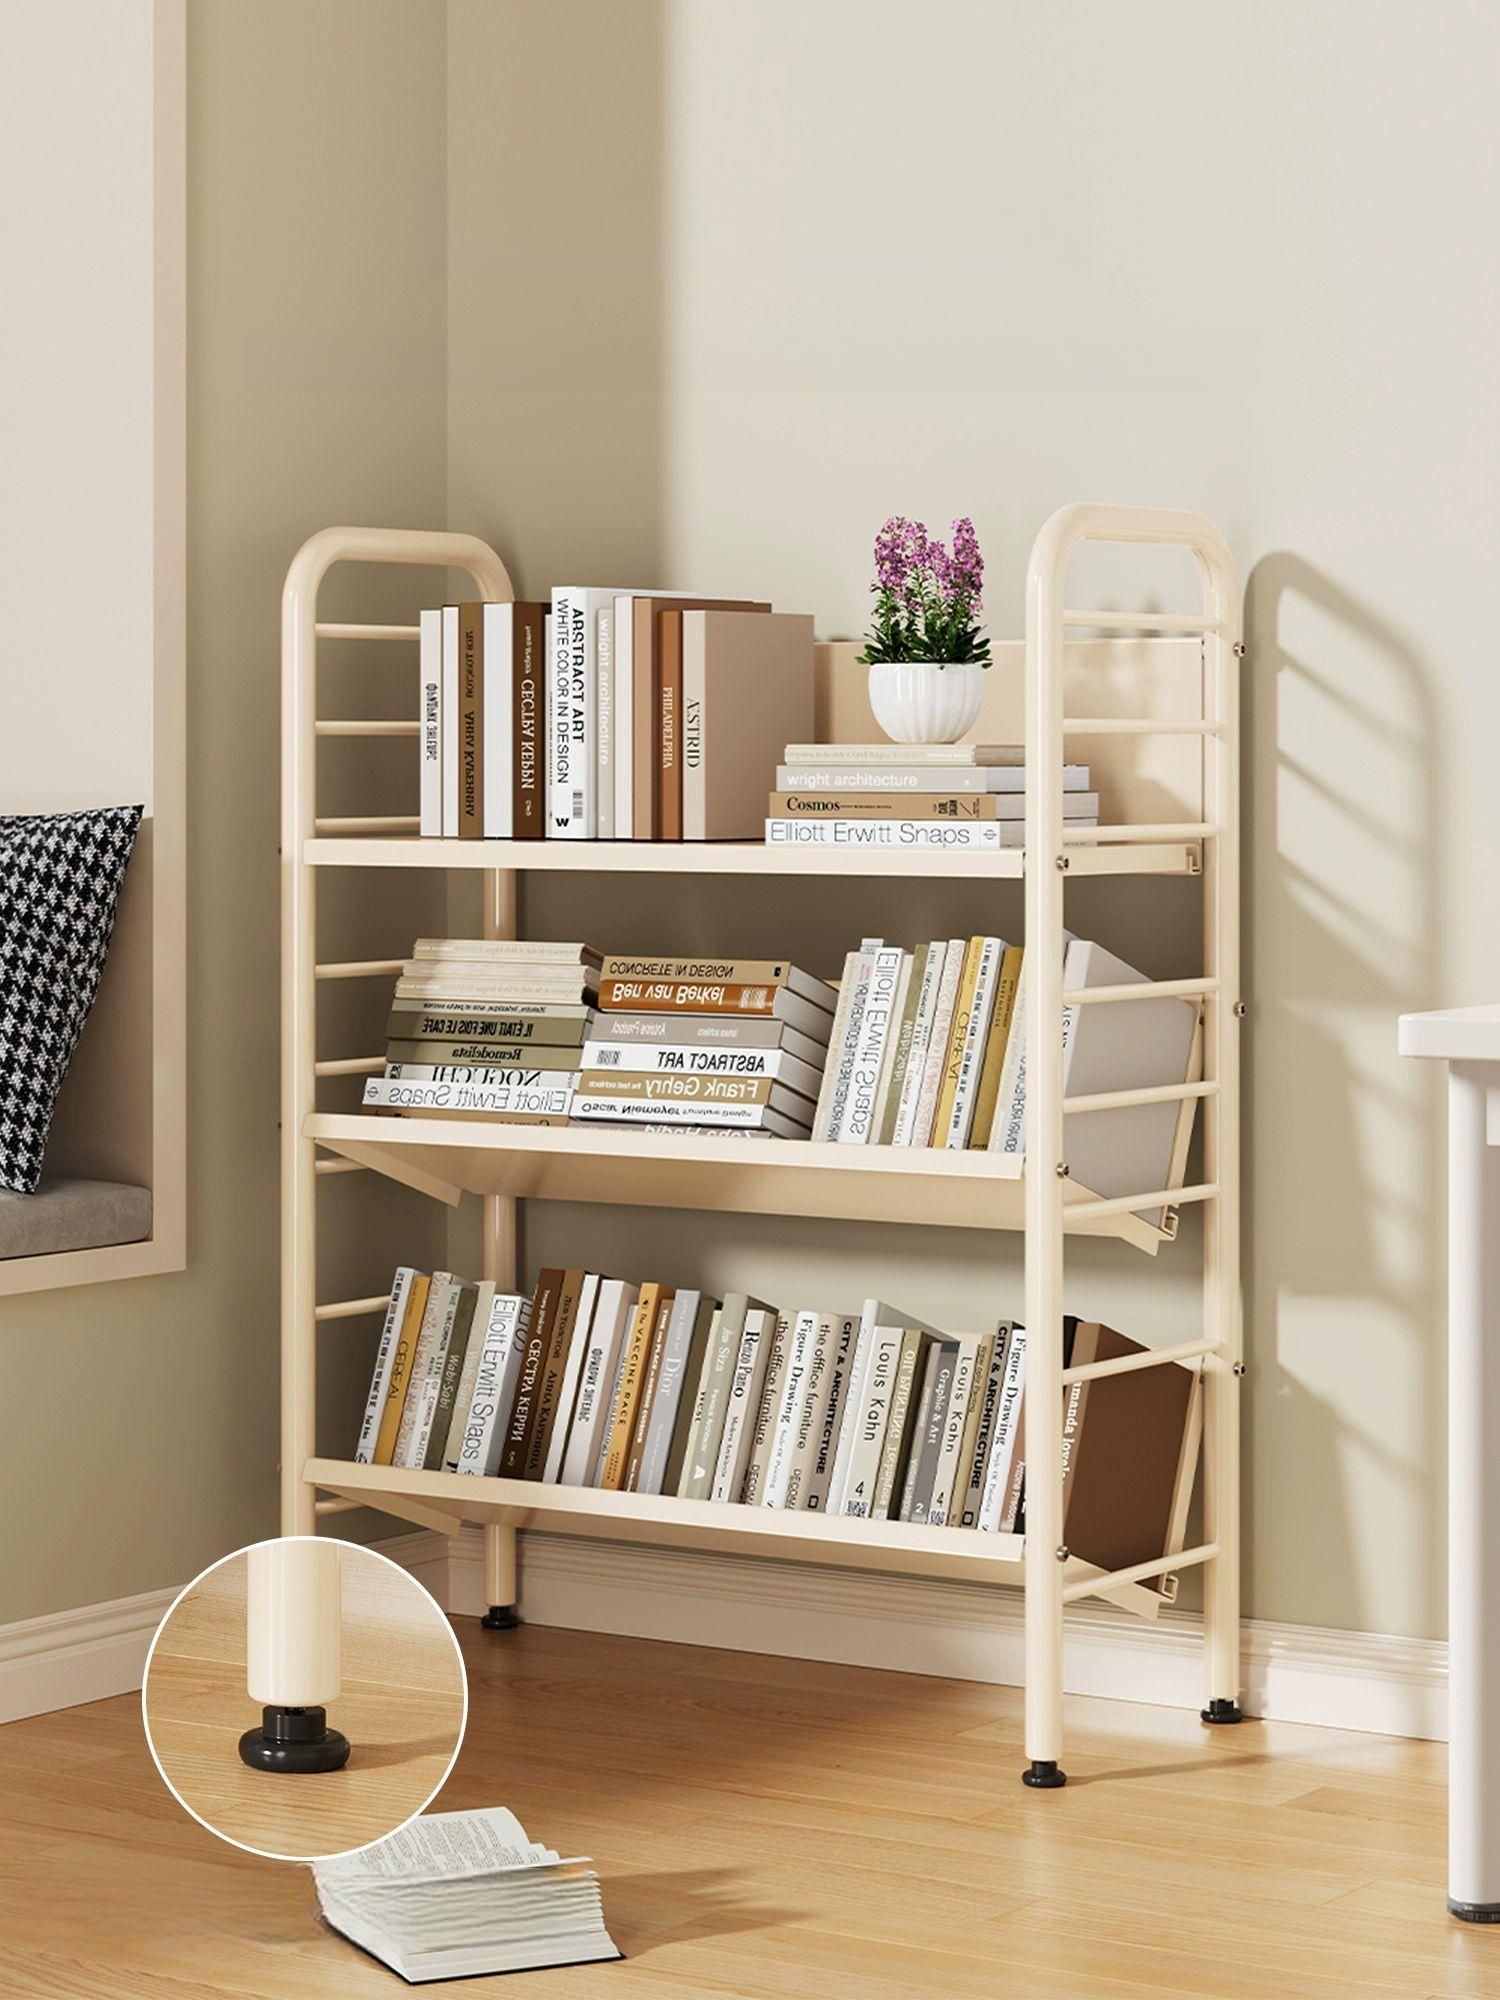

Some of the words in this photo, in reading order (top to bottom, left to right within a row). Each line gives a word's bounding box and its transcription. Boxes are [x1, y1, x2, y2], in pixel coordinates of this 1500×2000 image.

[557, 598, 569, 646] WHITE
[598, 618, 610, 667] wright
[557, 647, 569, 699] COLOR
[572, 608, 585, 703] ABSTRACT
[557, 701, 569, 717] IN
[572, 708, 585, 744] ART
[599, 672, 611, 765] architecture
[662, 686, 673, 769] PHILADELPHIA
[557, 720, 569, 785] DESIGN
[786, 774, 830, 788] wright
[833, 772, 918, 787] architecture
[786, 796, 841, 812] Cosmos
[770, 821, 827, 842] Elliott
[833, 822, 893, 843] Erwitt
[899, 823, 971, 848] Snaps
[486, 1299, 516, 1344] Elliott
[776, 1320, 789, 1342] the
[795, 1318, 813, 1362] Figure
[816, 1324, 830, 1345] the
[840, 1321, 852, 1353] CITY
[994, 1326, 1008, 1360] CITY
[520, 1339, 542, 1393] СЕСТРА
[626, 1327, 644, 1385] VACCINE
[739, 1331, 760, 1364] Renzo
[837, 1355, 846, 1365] &
[873, 1342, 896, 1388] Louis
[990, 1362, 1000, 1374] &
[1009, 1337, 1026, 1382] Figure
[439, 1354, 460, 1410] Wabi-Sabi
[476, 1349, 506, 1397] Erwitt
[660, 1357, 682, 1397] Dior
[733, 1365, 753, 1398] Piano
[780, 1366, 804, 1424] Drawing
[934, 1368, 950, 1411] Graphic
[955, 1356, 973, 1400] Louis
[511, 1397, 531, 1441] КЕРРИ
[618, 1391, 631, 1425] RACE
[756, 1388, 777, 1446] furniture
[797, 1392, 819, 1450] furniture
[816, 1370, 843, 1474] ARCHITECTURE
[864, 1398, 886, 1441] Kahn
[932, 1413, 942, 1423] &
[995, 1386, 1018, 1446] Drawing
[928, 1424, 940, 1444] Art
[946, 1410, 963, 1452] Kahn
[970, 1379, 998, 1489] ARCHITECTURE
[855, 1481, 865, 1497] 4
[915, 1502, 924, 1513] 2
